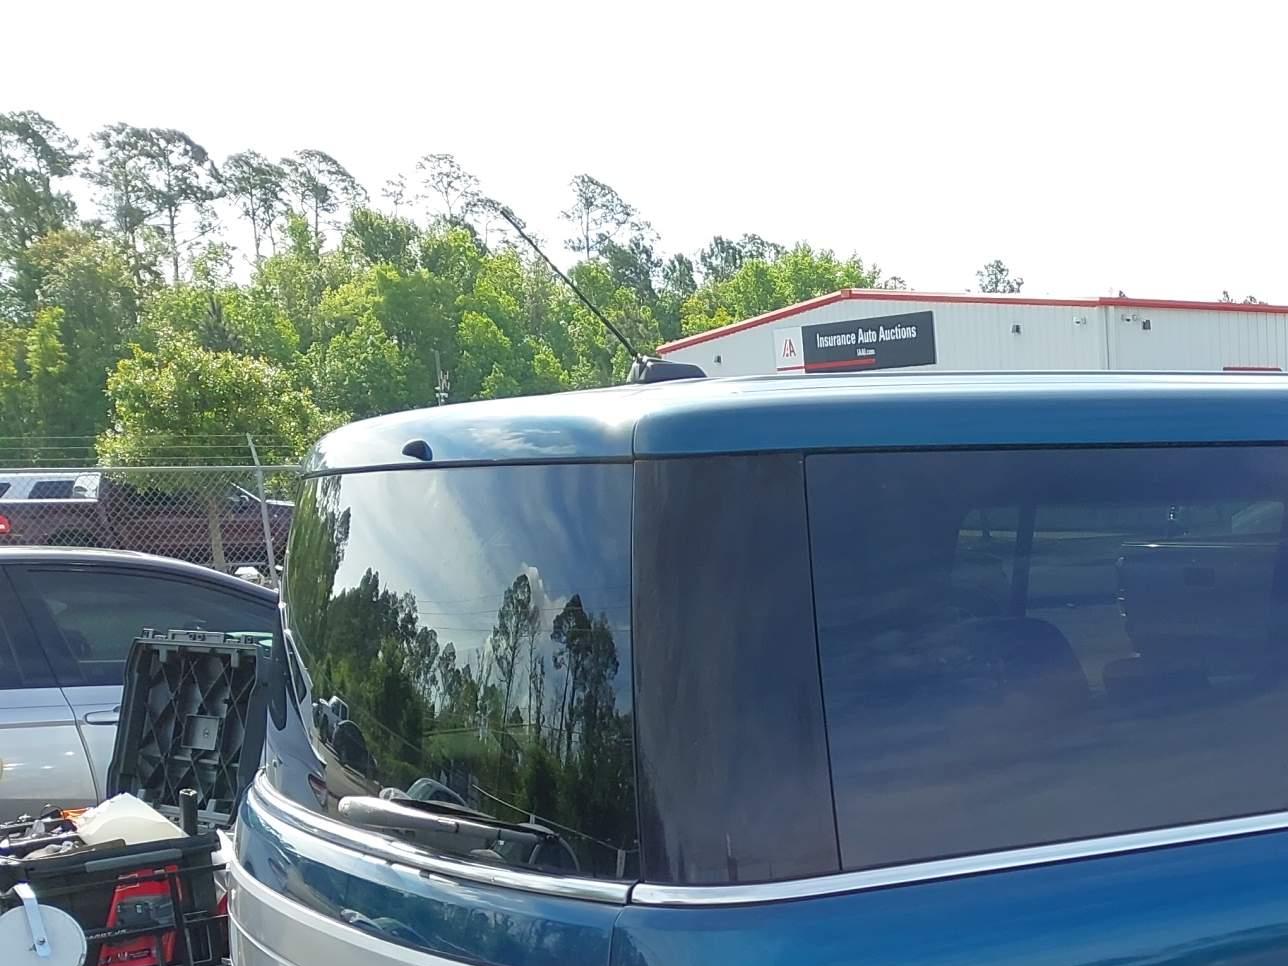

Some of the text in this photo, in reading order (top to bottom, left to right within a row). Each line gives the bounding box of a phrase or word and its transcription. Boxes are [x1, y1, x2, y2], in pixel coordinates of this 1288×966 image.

[816, 324, 917, 348] Insurance Auto Auctions
